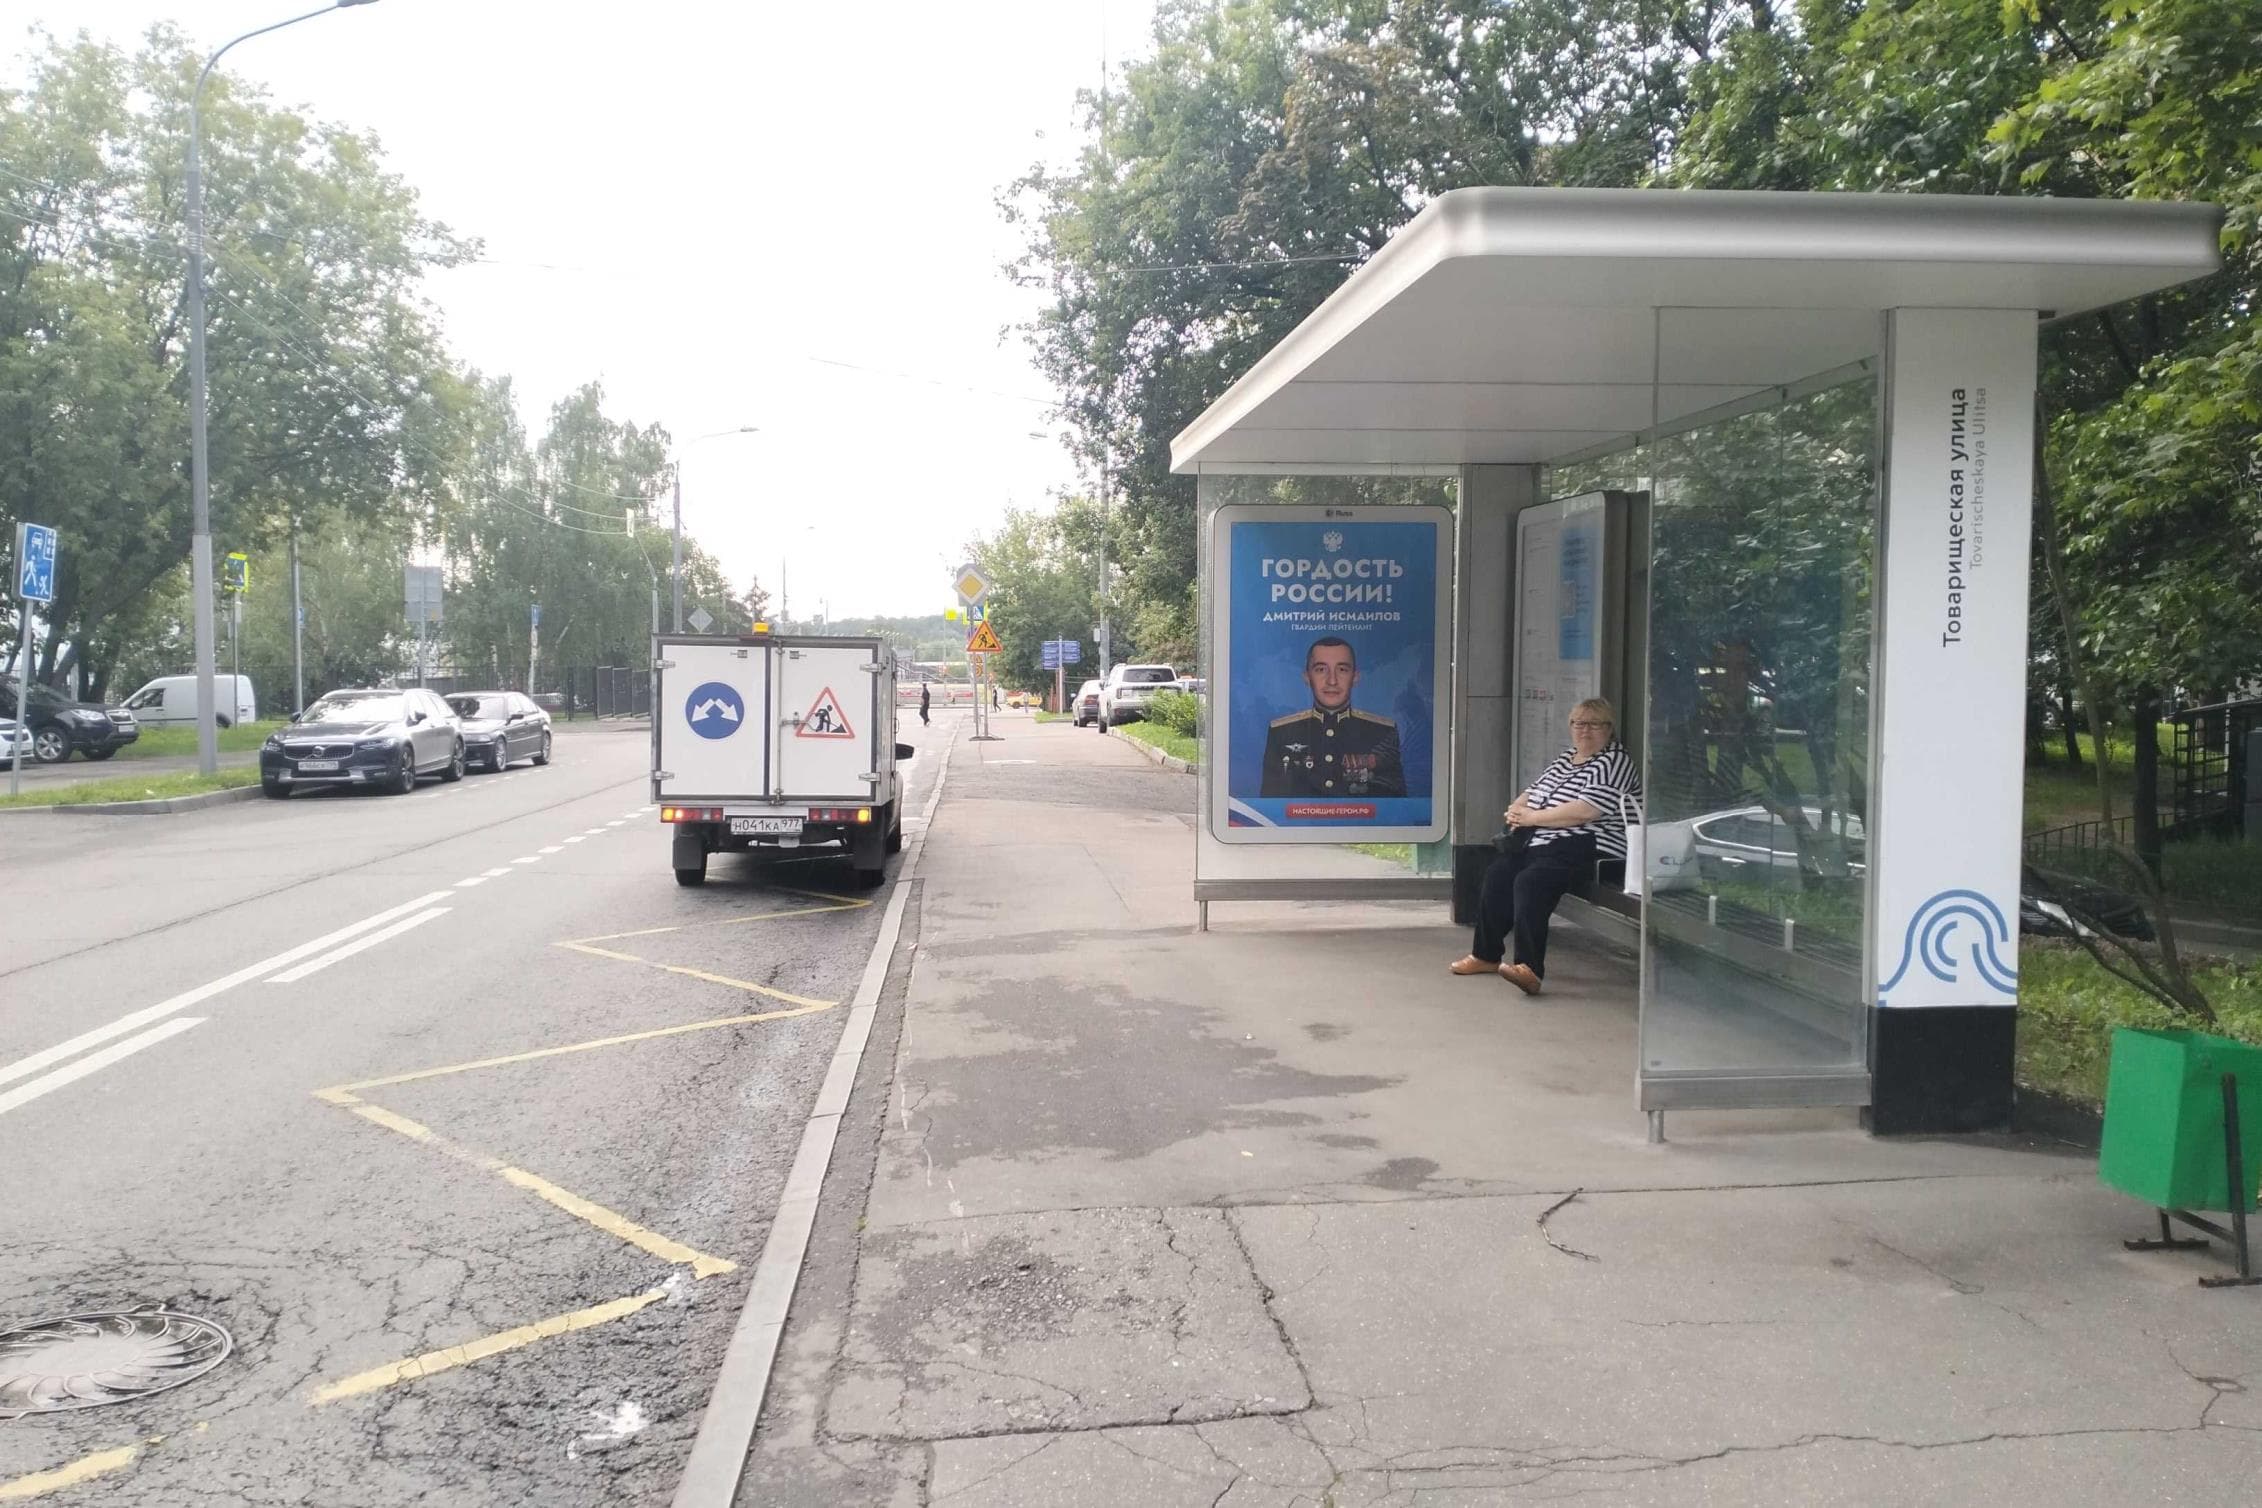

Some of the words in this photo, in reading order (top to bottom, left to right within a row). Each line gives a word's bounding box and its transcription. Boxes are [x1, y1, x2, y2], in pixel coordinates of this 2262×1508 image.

[1951, 388, 1969, 462] улица
[1972, 388, 1986, 435] Ulitsa
[1970, 440, 1988, 569] Tovarischeskaya
[1262, 559, 1404, 580] ГОРДОСТЬ
[1943, 469, 1966, 648] Товарищеская
[1271, 583, 1393, 603] РОССИИ!
[1263, 609, 1325, 622] ДМИТРИЙ
[1329, 611, 1401, 621] ИСМАИЛОВ
[782, 819, 799, 828] 977
